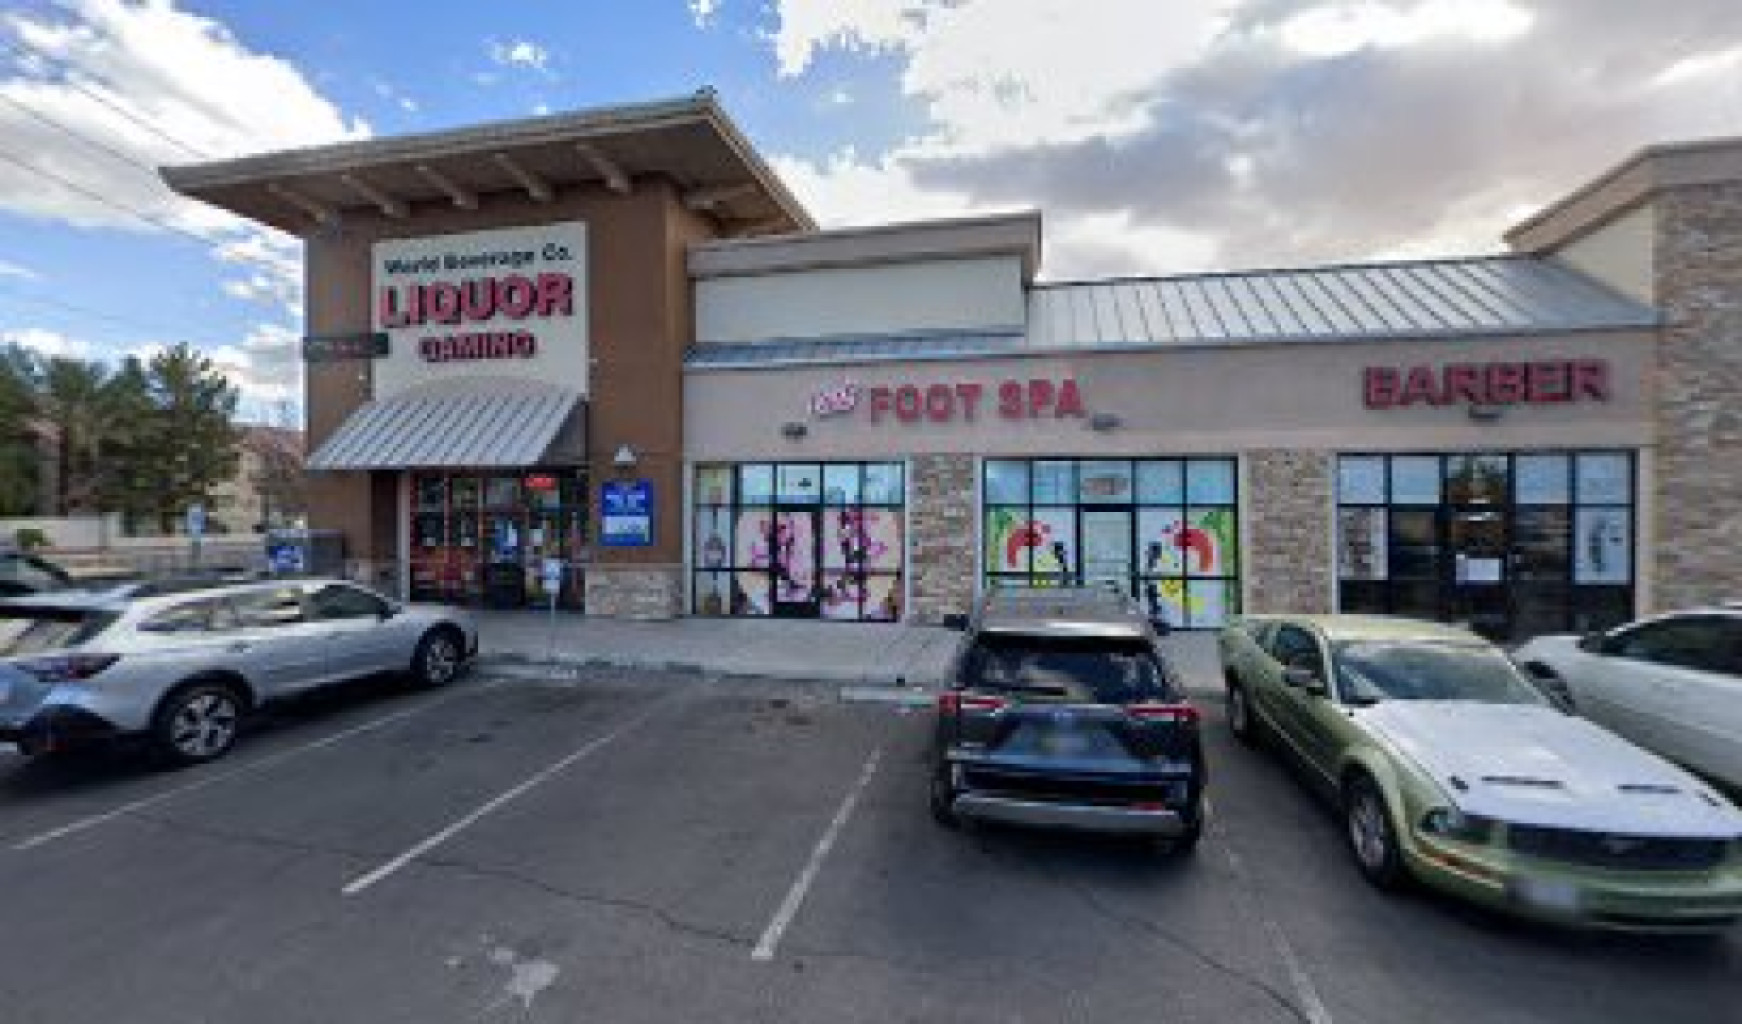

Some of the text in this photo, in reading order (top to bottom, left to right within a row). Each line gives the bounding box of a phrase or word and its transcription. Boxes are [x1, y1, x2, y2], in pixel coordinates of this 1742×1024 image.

[444, 250, 534, 270] Beverage
[542, 243, 573, 261] Co.
[380, 273, 574, 327] LIQUOR
[418, 332, 537, 362] GAMING
[870, 382, 983, 424] FOOT
[999, 379, 1086, 419] SPA
[1364, 359, 1611, 409] BARBER
